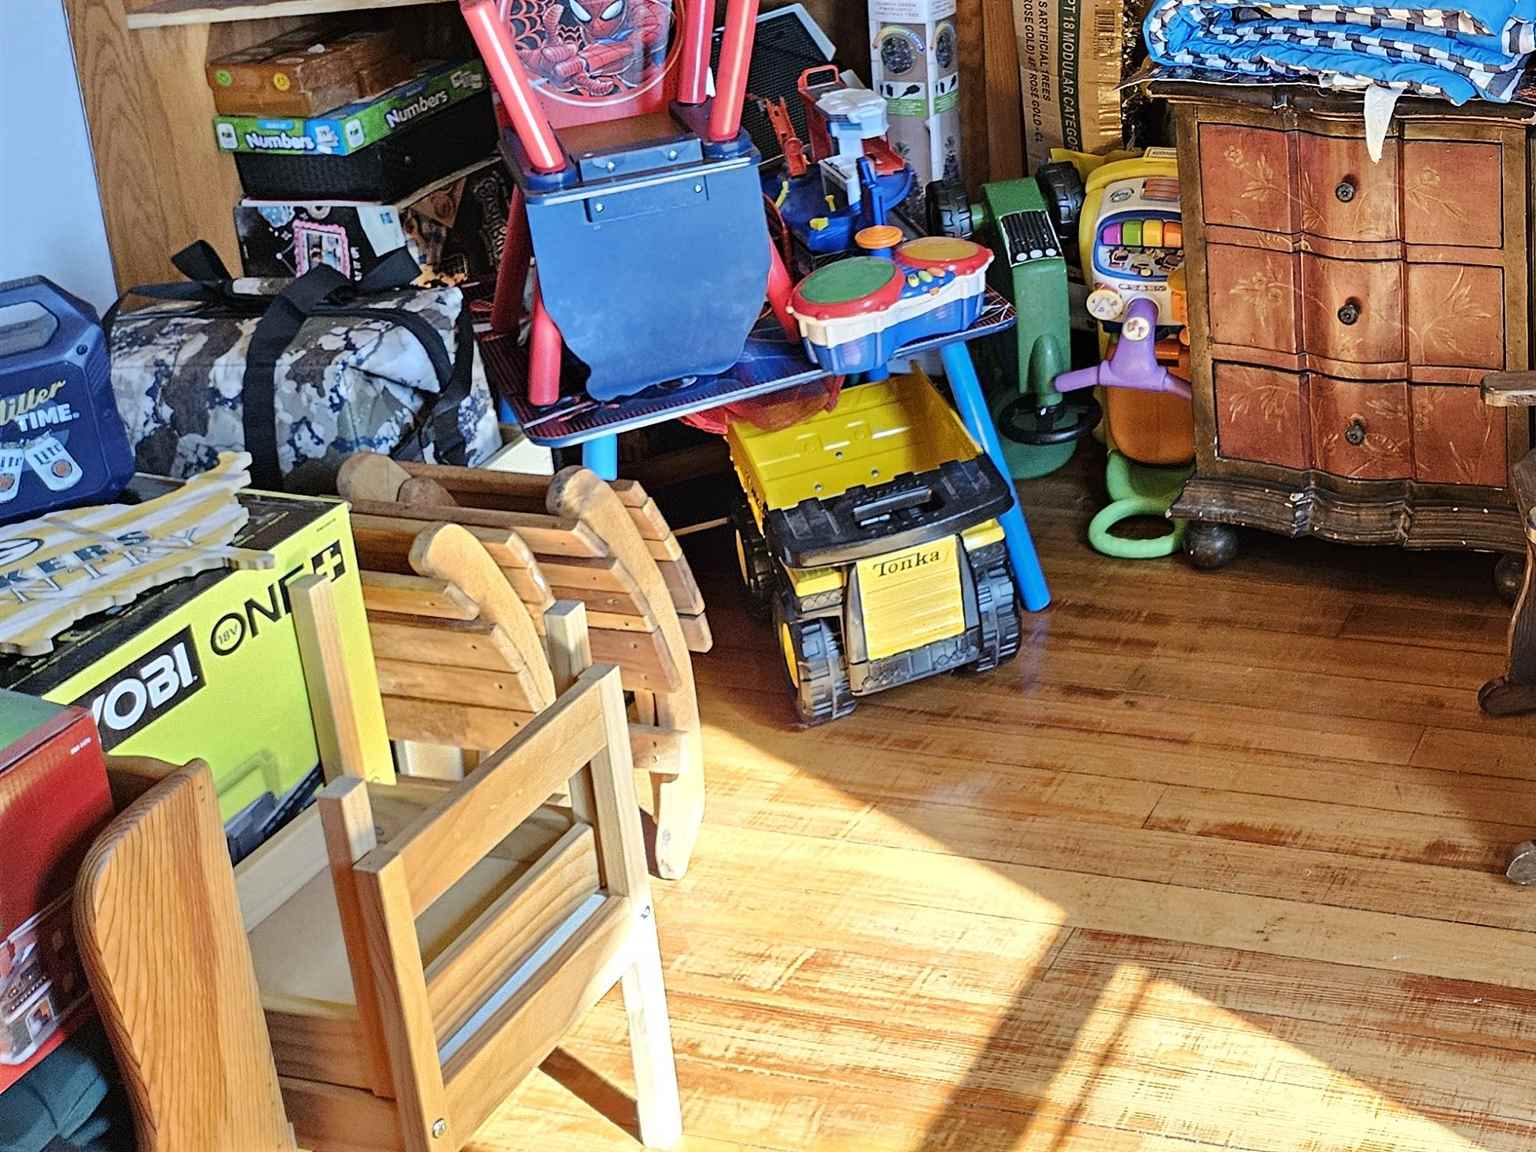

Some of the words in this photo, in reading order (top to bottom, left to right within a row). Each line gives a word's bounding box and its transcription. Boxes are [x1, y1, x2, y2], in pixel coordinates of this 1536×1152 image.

[1062, 16, 1076, 30] 18
[1038, 9, 1049, 70] ARTIFICIAL
[1061, 31, 1075, 95] MODULAR
[1028, 71, 1040, 98] ROSE
[1039, 70, 1051, 102] TREES
[385, 90, 449, 130] Numbers
[1030, 98, 1043, 131] GOLD
[244, 131, 316, 151] Numbers
[872, 550, 941, 577] Tonka
[92, 641, 198, 731] OBI
